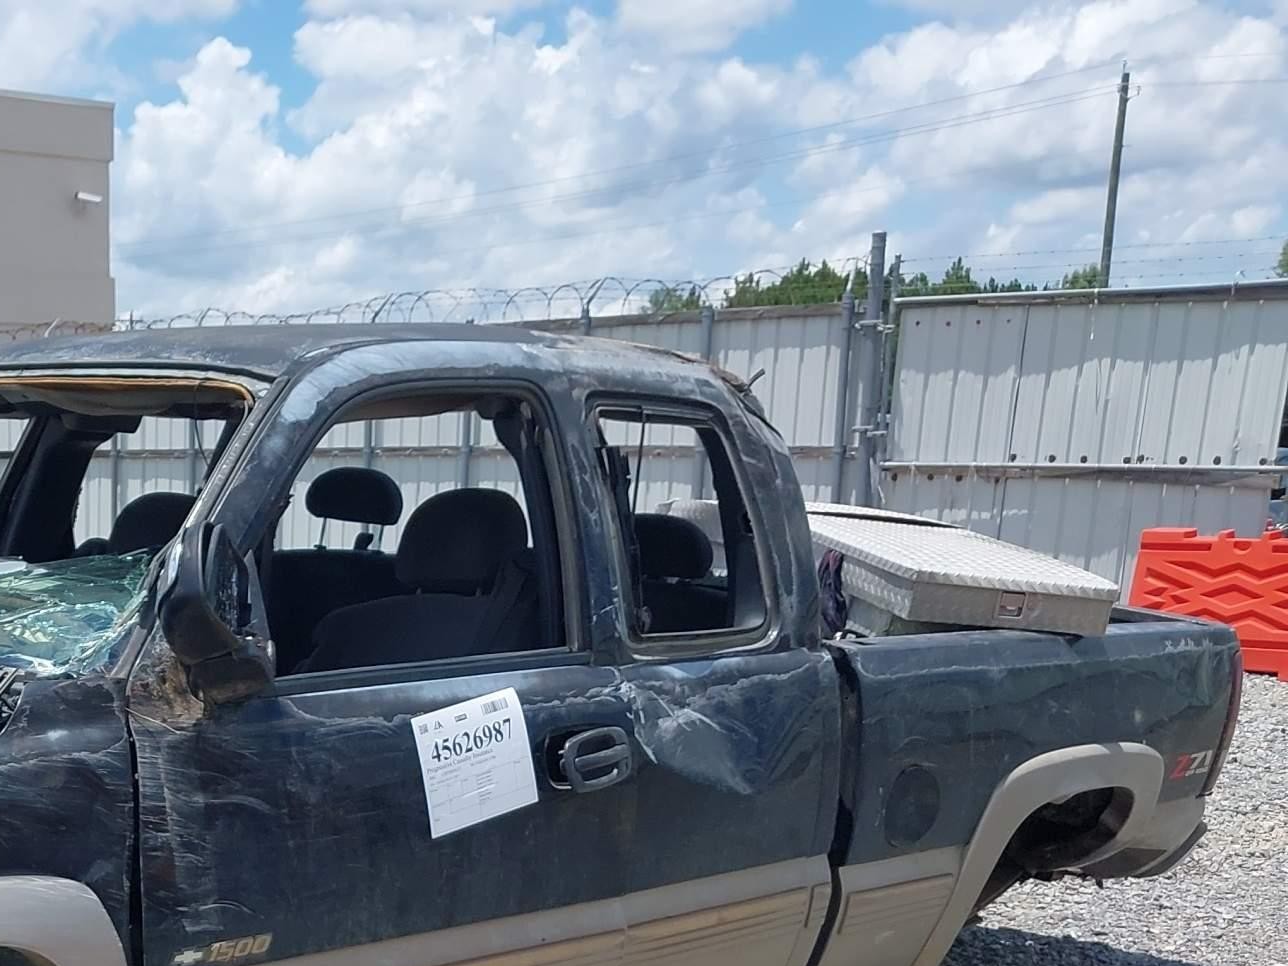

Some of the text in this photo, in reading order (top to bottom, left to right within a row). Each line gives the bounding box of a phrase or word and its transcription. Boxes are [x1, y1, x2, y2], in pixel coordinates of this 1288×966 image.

[431, 717, 512, 763] 45626987
[1169, 749, 1214, 780] Z71
[208, 933, 272, 961] 1500
